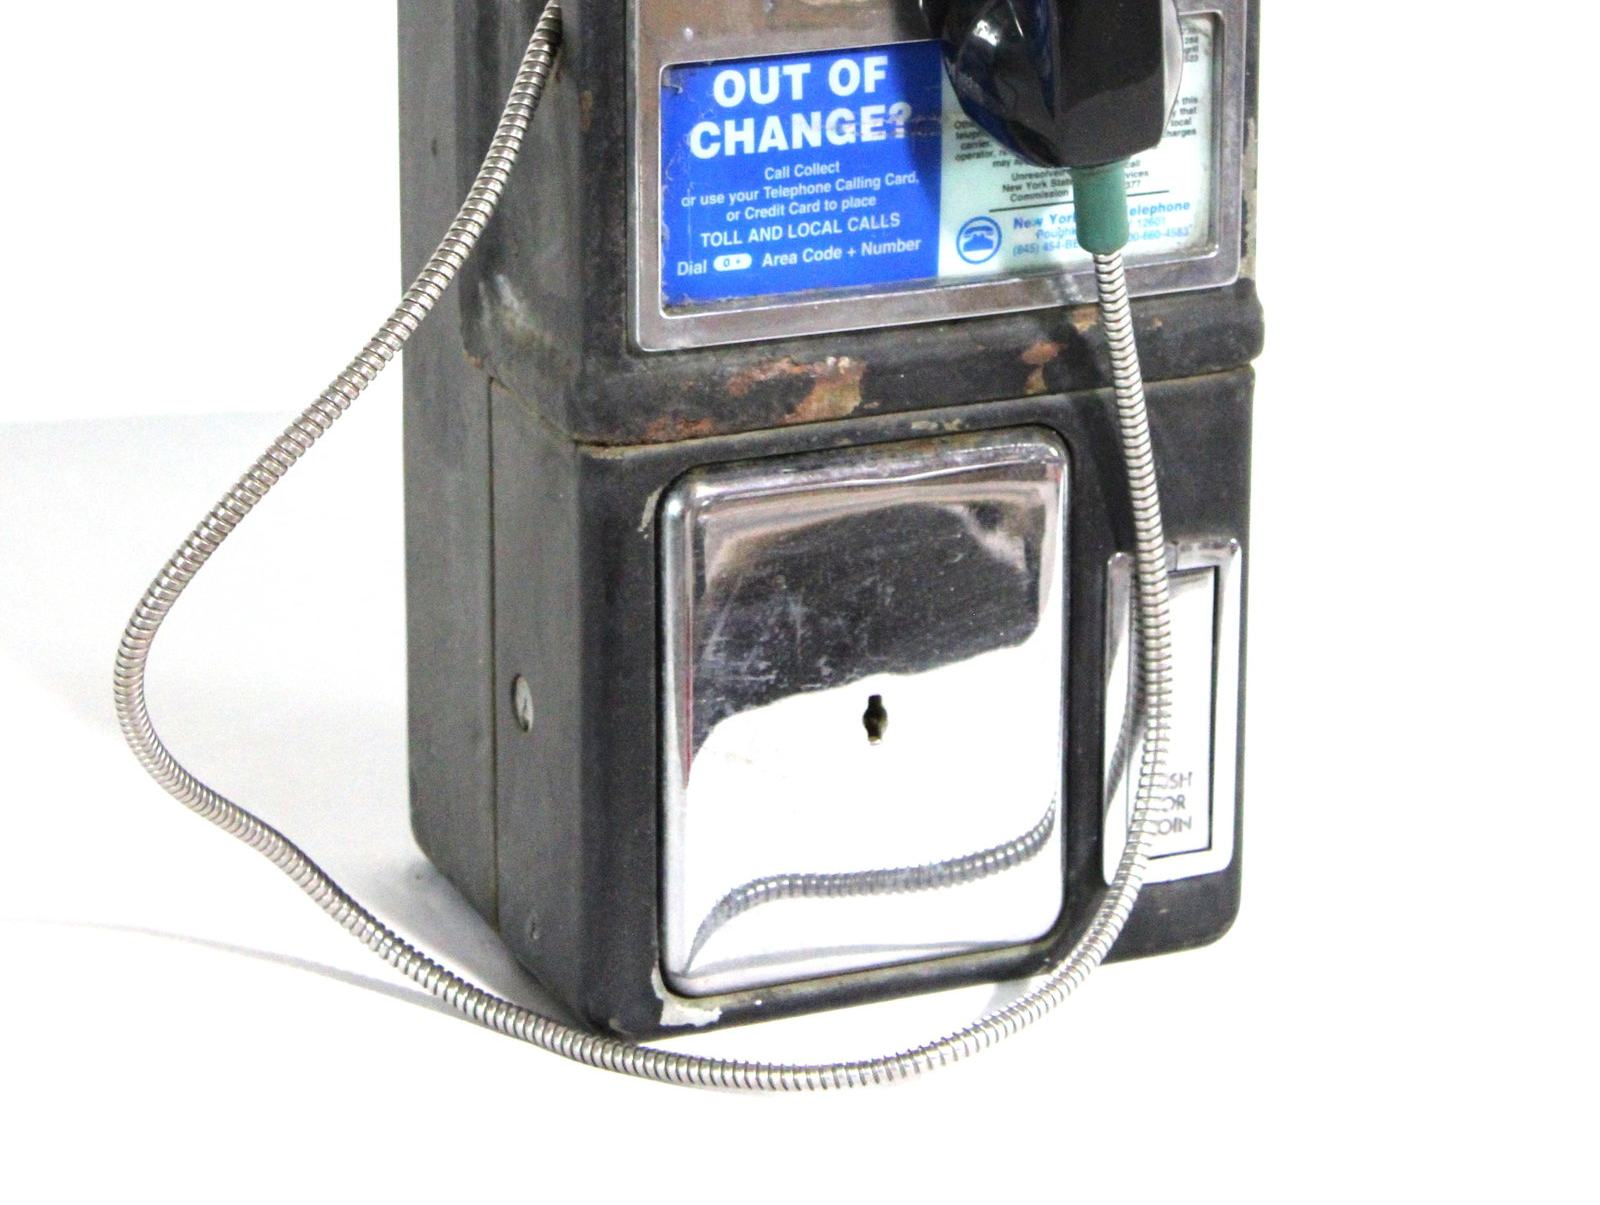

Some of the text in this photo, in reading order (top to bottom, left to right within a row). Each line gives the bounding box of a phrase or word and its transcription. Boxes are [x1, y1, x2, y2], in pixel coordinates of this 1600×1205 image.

[713, 56, 887, 108] OUT OF
[690, 101, 912, 159] CHANGE?
[1166, 129, 1197, 138] harges
[764, 161, 840, 180] Call Collect
[1002, 183, 1022, 192] New
[1026, 181, 1047, 190] York
[1125, 171, 1150, 179] vices
[681, 195, 696, 207] or
[700, 193, 725, 206] use
[729, 190, 759, 206] your
[764, 181, 832, 200] Telephone
[835, 175, 881, 193] Calling
[1010, 189, 1069, 202] Commission
[726, 194, 877, 221] or Credit Card to place
[1013, 217, 1043, 229] New
[1129, 201, 1191, 218] elephone
[700, 213, 901, 248] TOLL AND LOCAL CALLS
[677, 259, 707, 277] Dial
[762, 252, 798, 268] Area
[802, 246, 842, 263] Code
[847, 248, 856, 258] +
[861, 237, 922, 256] Number
[1157, 815, 1193, 836] OIN
